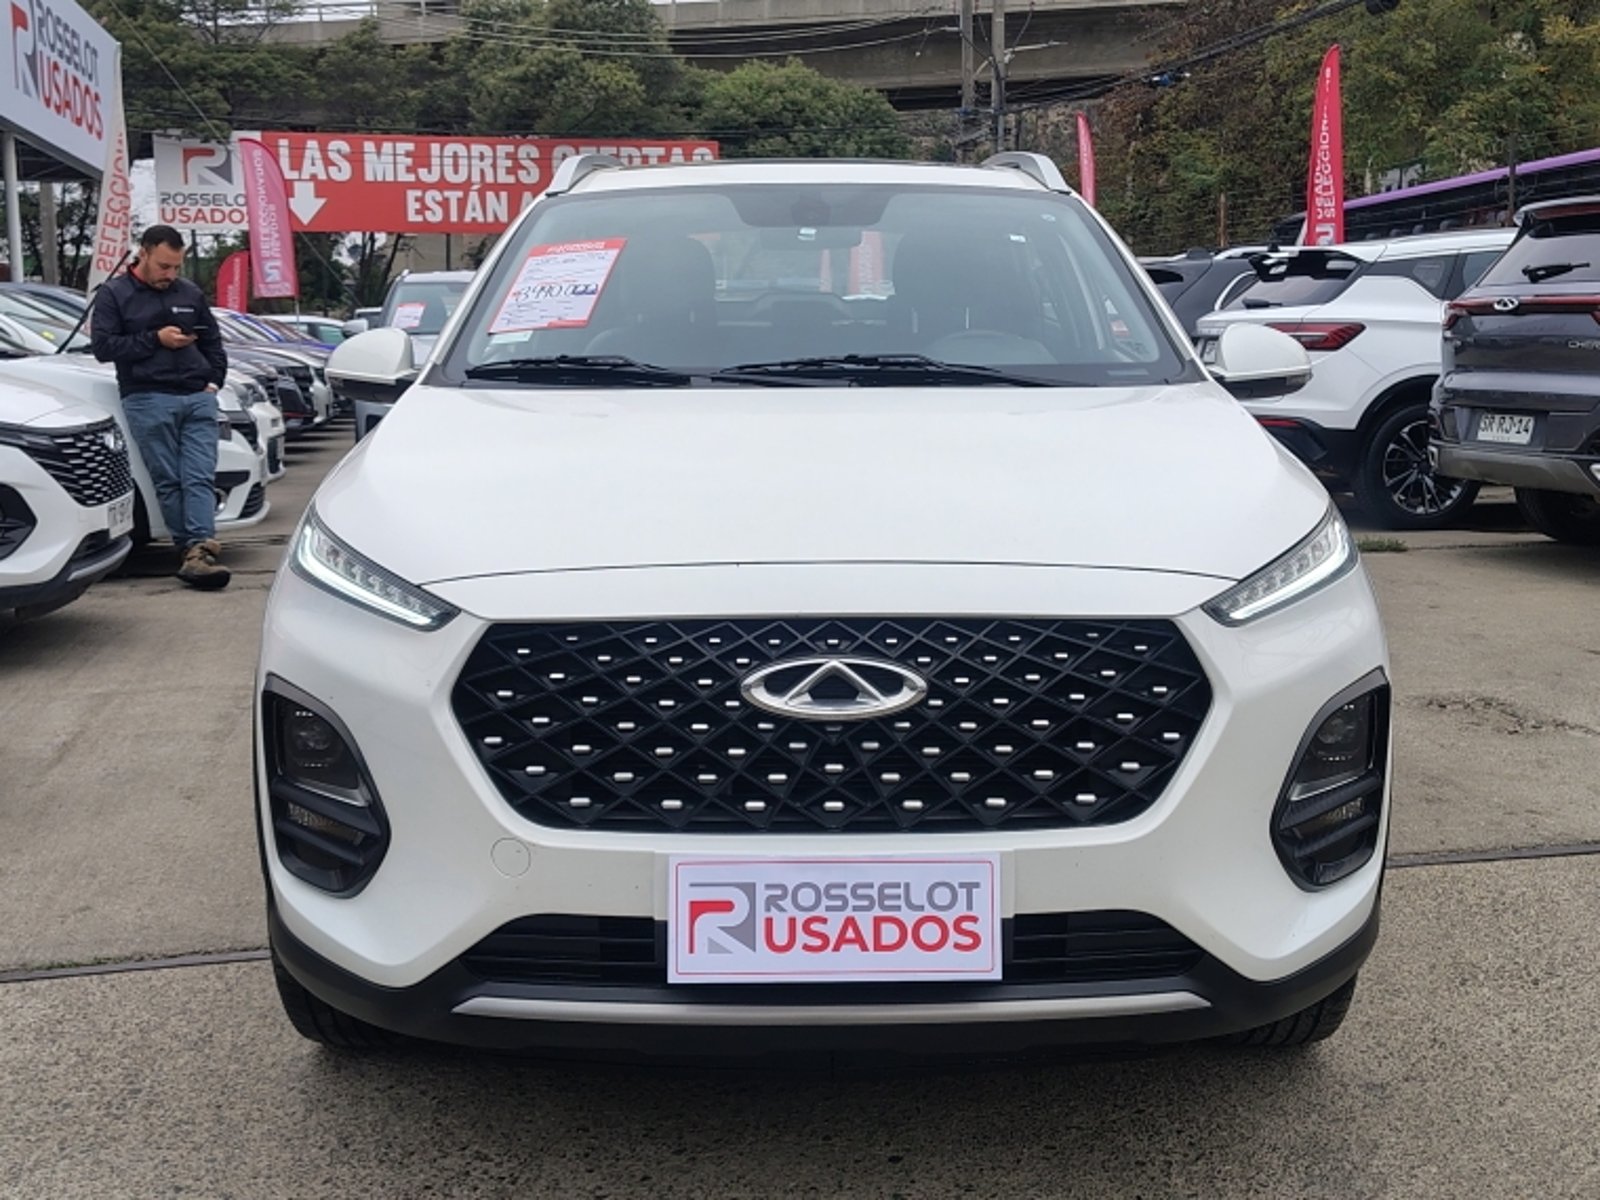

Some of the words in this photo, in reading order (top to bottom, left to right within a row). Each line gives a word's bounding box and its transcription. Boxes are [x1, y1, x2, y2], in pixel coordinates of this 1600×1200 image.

[36, 0, 99, 87] ROSSELOT
[39, 50, 104, 141] USADOS
[278, 139, 352, 182] LAS
[363, 141, 540, 184] MEJORES
[161, 192, 248, 208] ROSSELO
[161, 206, 249, 225] USADO
[406, 184, 508, 222] ESTÁN
[764, 881, 981, 913] ROSSELOT
[764, 914, 982, 954] USADOS
